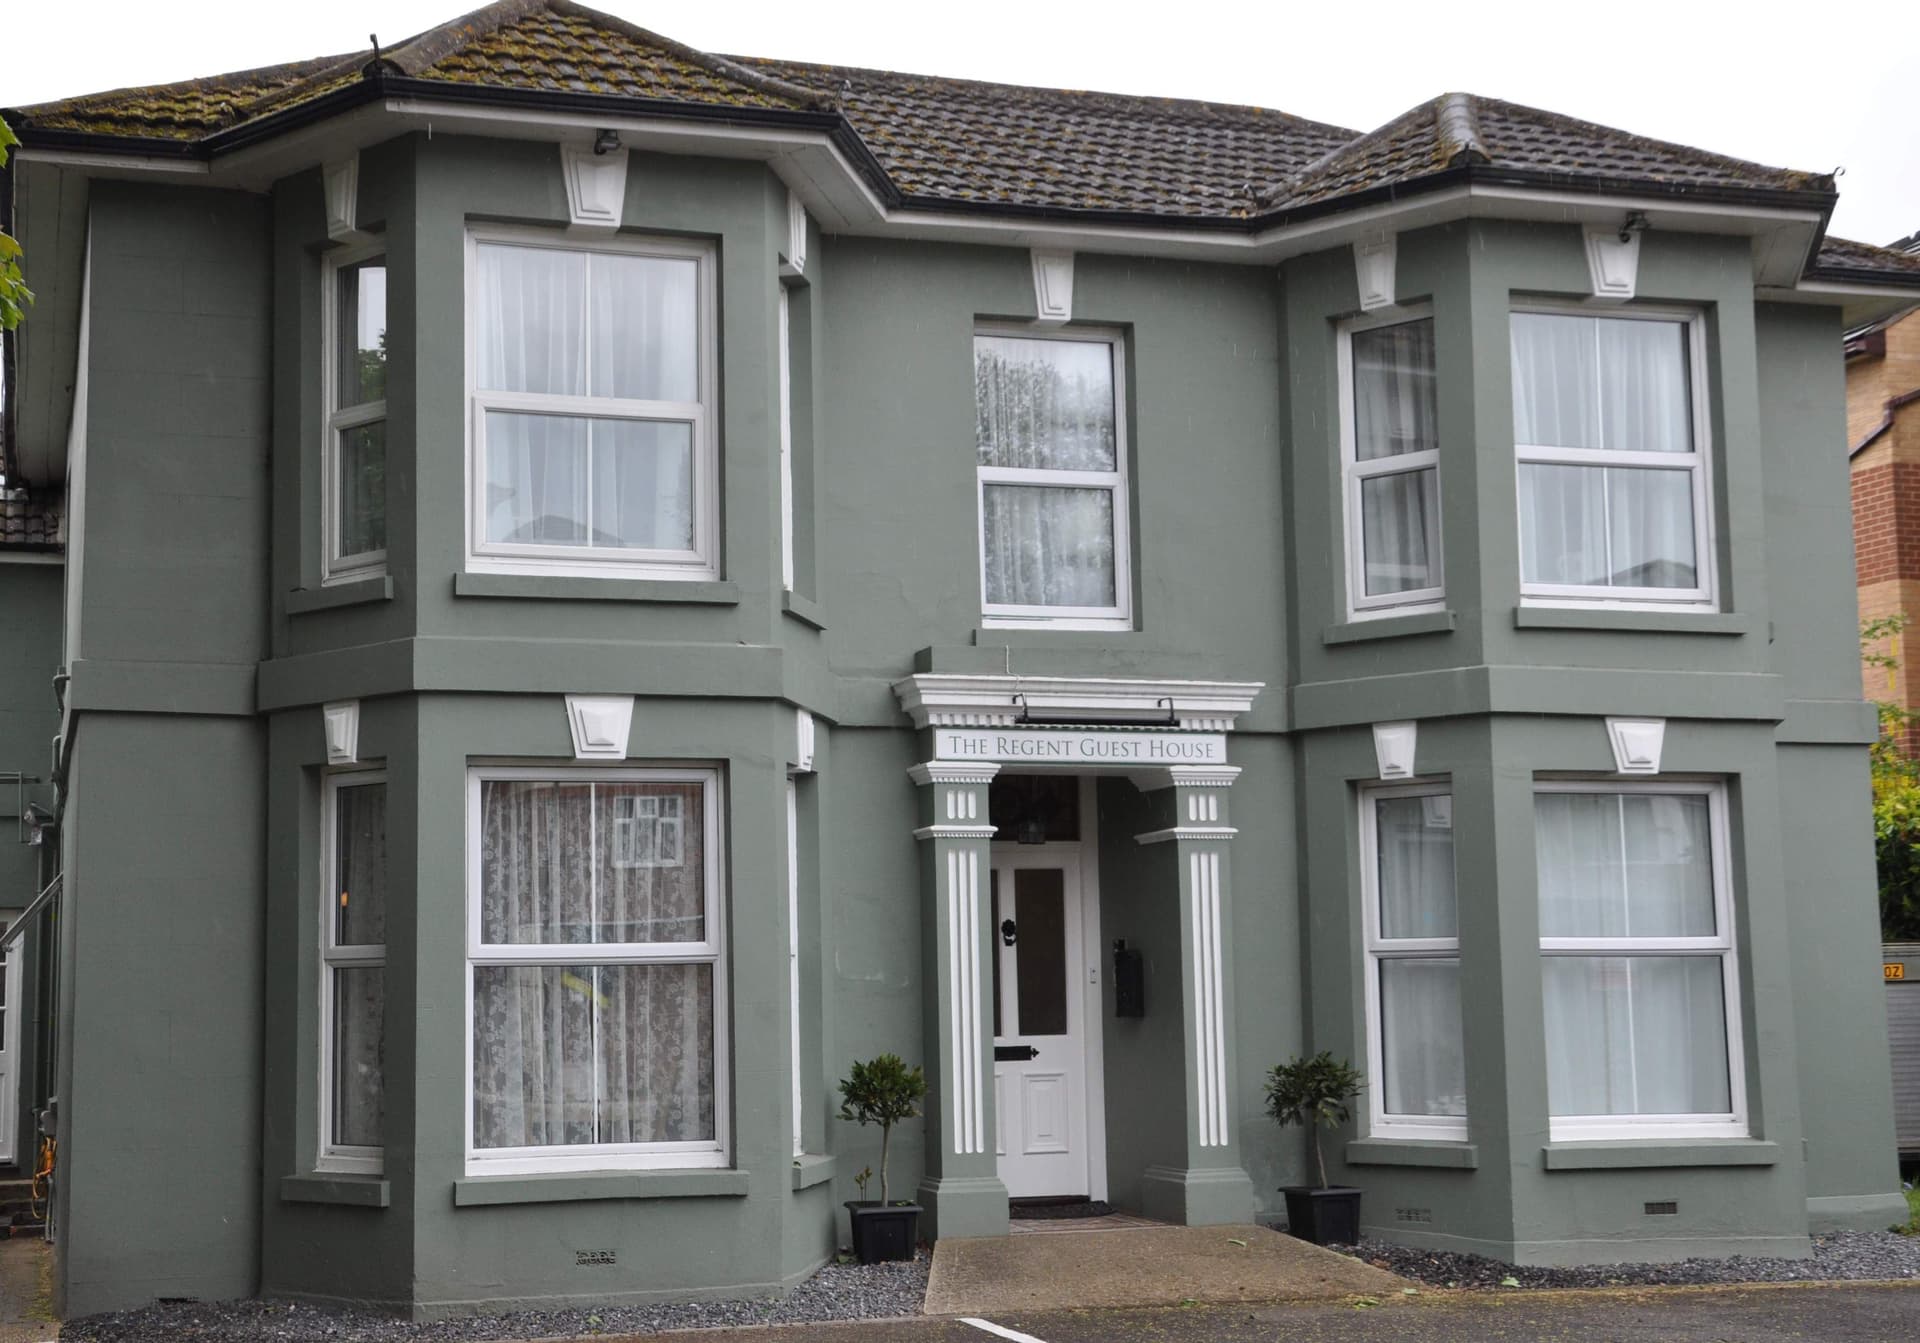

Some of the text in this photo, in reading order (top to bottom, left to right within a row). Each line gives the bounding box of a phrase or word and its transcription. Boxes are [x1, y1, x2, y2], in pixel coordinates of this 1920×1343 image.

[949, 736, 1214, 759] THE REGENT GUEST HOUSE
